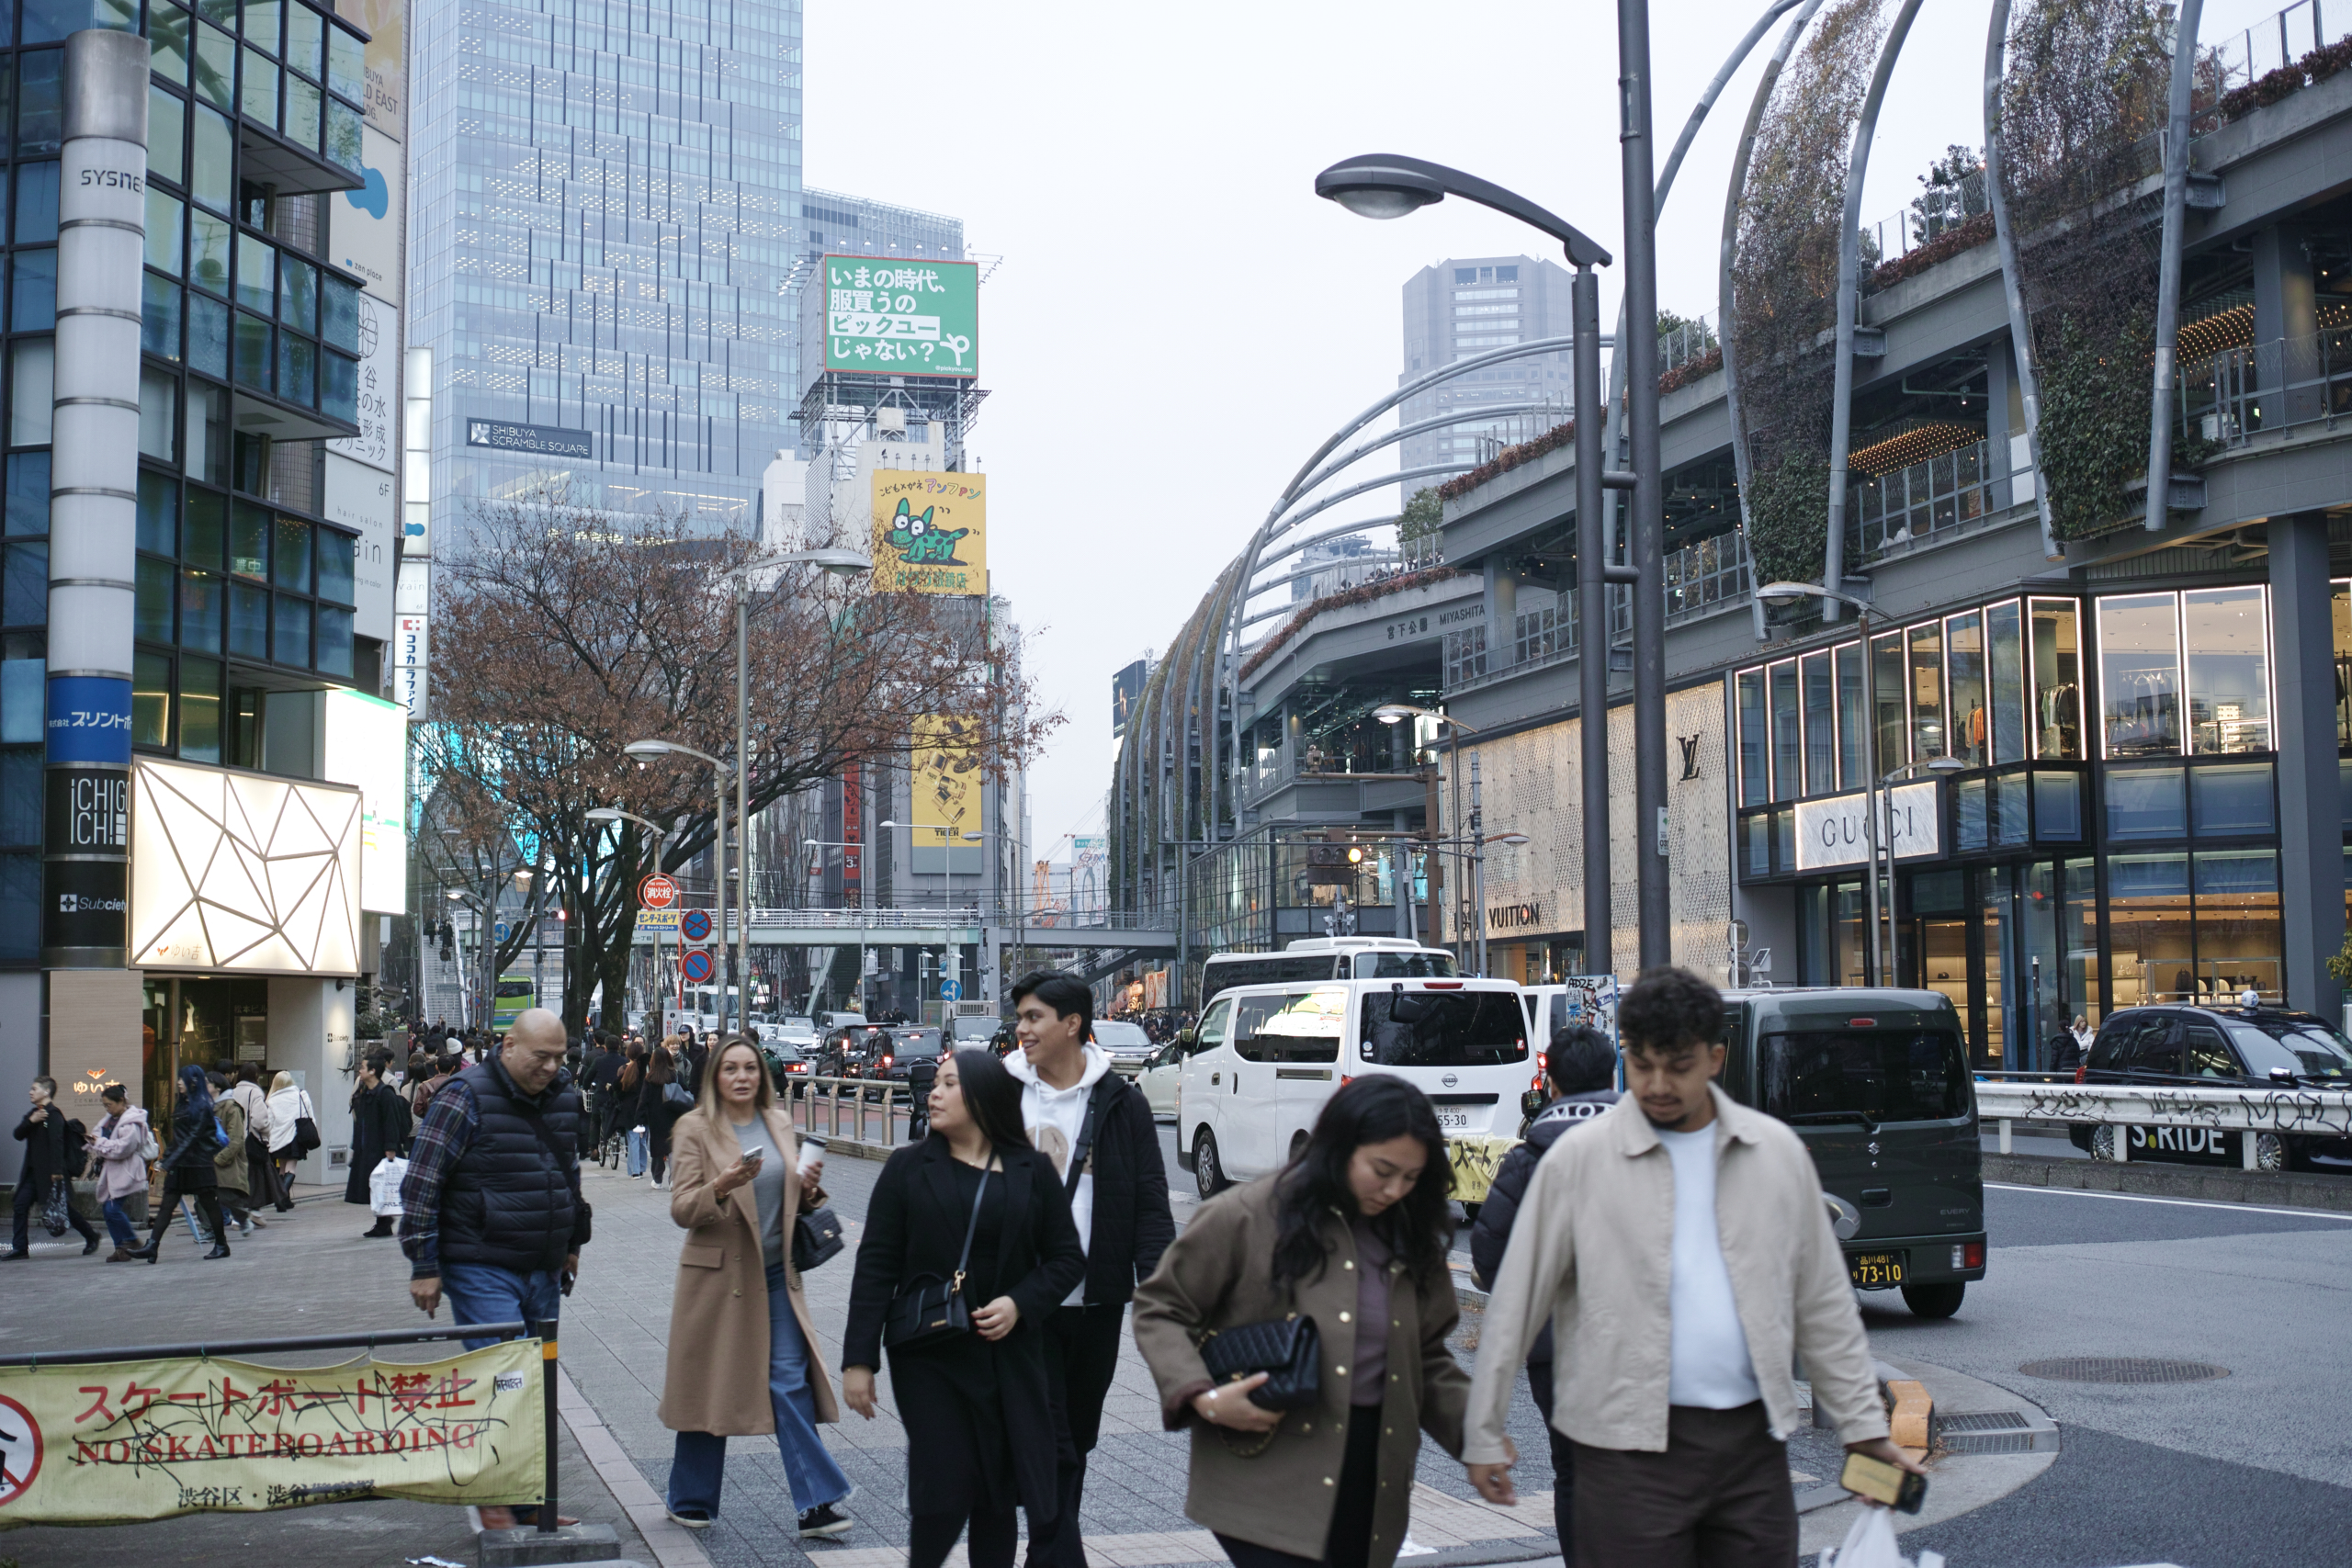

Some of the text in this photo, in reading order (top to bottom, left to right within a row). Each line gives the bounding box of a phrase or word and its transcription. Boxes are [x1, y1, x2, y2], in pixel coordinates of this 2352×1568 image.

[376, 89, 398, 115] EAST
[355, 263, 382, 282] zen place
[831, 266, 945, 293] いまの時代、
[830, 288, 917, 314] 服買うの
[834, 314, 937, 335] ピックユー
[492, 424, 537, 438] SHIBUYA
[492, 435, 589, 455] SCRAMBLE SQUARE
[379, 482, 390, 497] 6F
[337, 505, 383, 529] hair salon
[398, 582, 425, 591] vain
[1439, 604, 1486, 626] MIYASHITA
[647, 886, 672, 899] 消火栓
[79, 897, 127, 913] Subciety
[639, 913, 677, 923] センタースポーツ
[1488, 902, 1540, 931] VUITTON
[171, 943, 201, 960] ゆい吉
[1860, 1264, 1902, 1283] 73-10
[74, 1368, 476, 1424] スケートボード禁止
[75, 1423, 476, 1467] NO SKATEBOARDING
